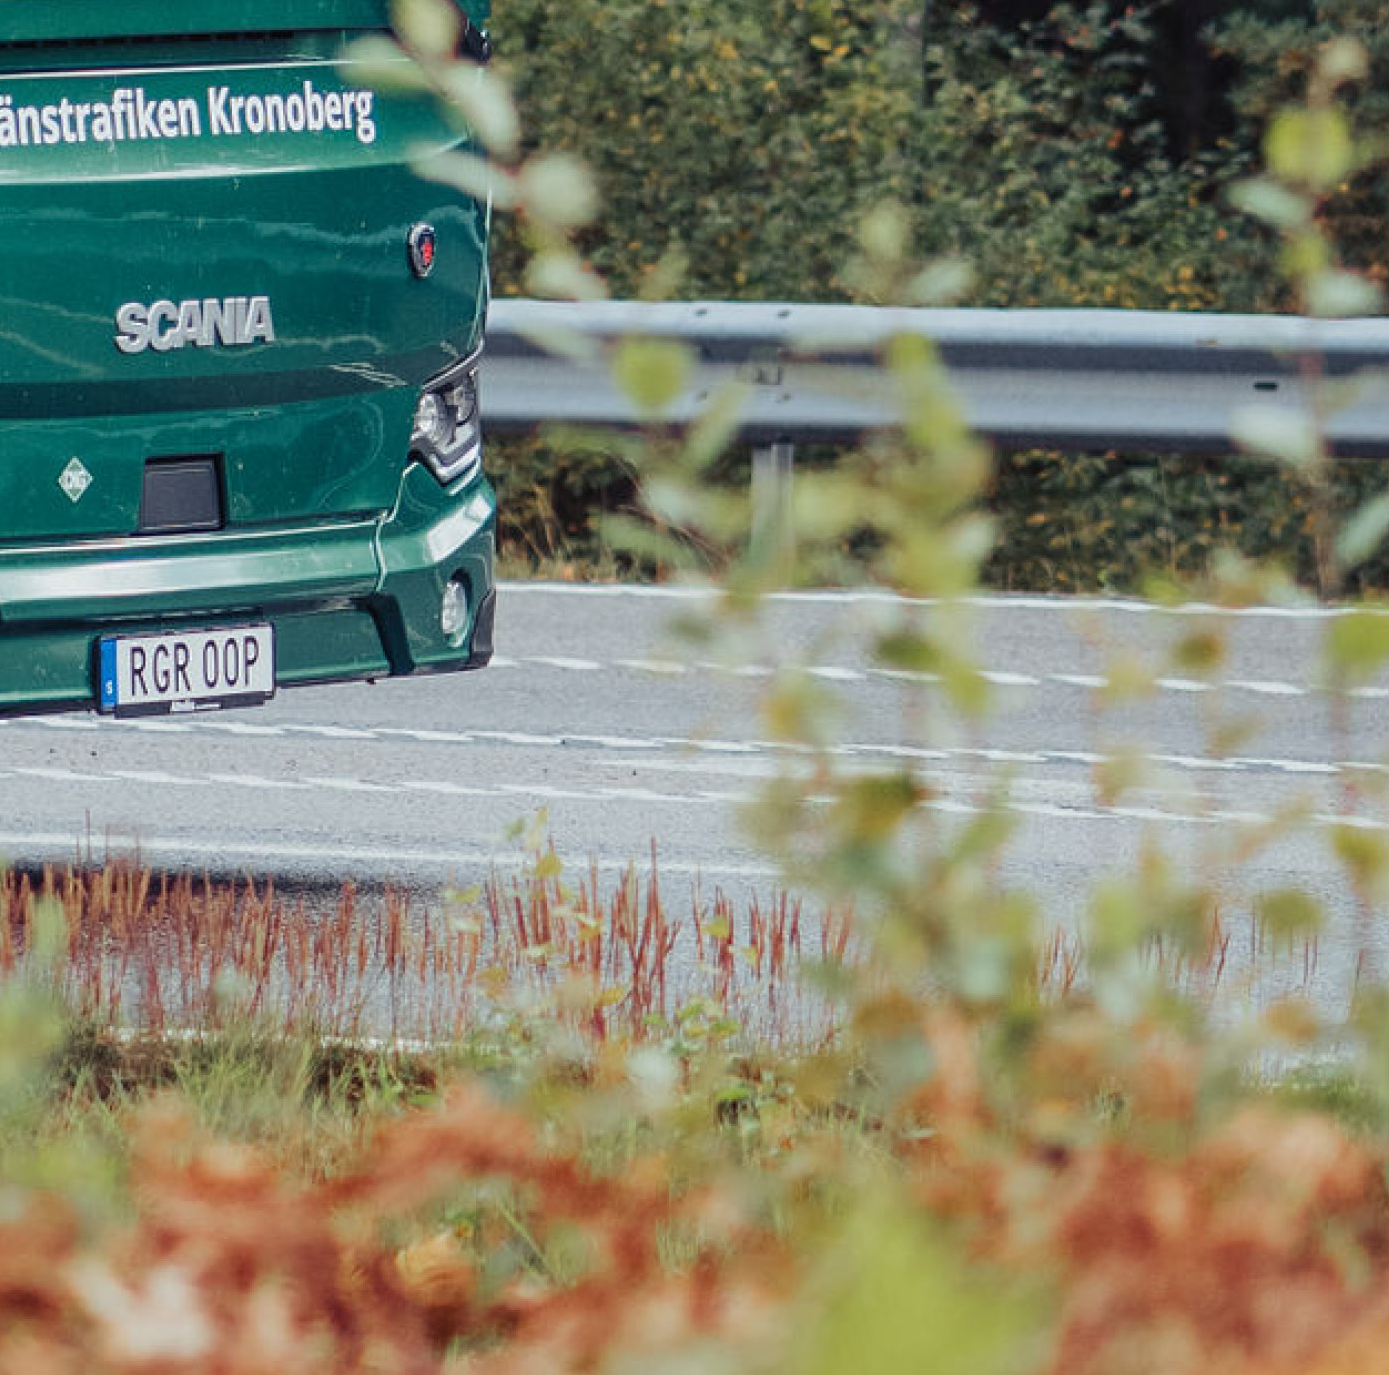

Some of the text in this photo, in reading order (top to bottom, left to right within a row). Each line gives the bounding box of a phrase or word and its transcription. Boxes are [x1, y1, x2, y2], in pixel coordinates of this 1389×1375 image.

[207, 81, 377, 144] Kronoberg
[115, 295, 276, 355] SCANIA
[130, 642, 191, 696] RGR
